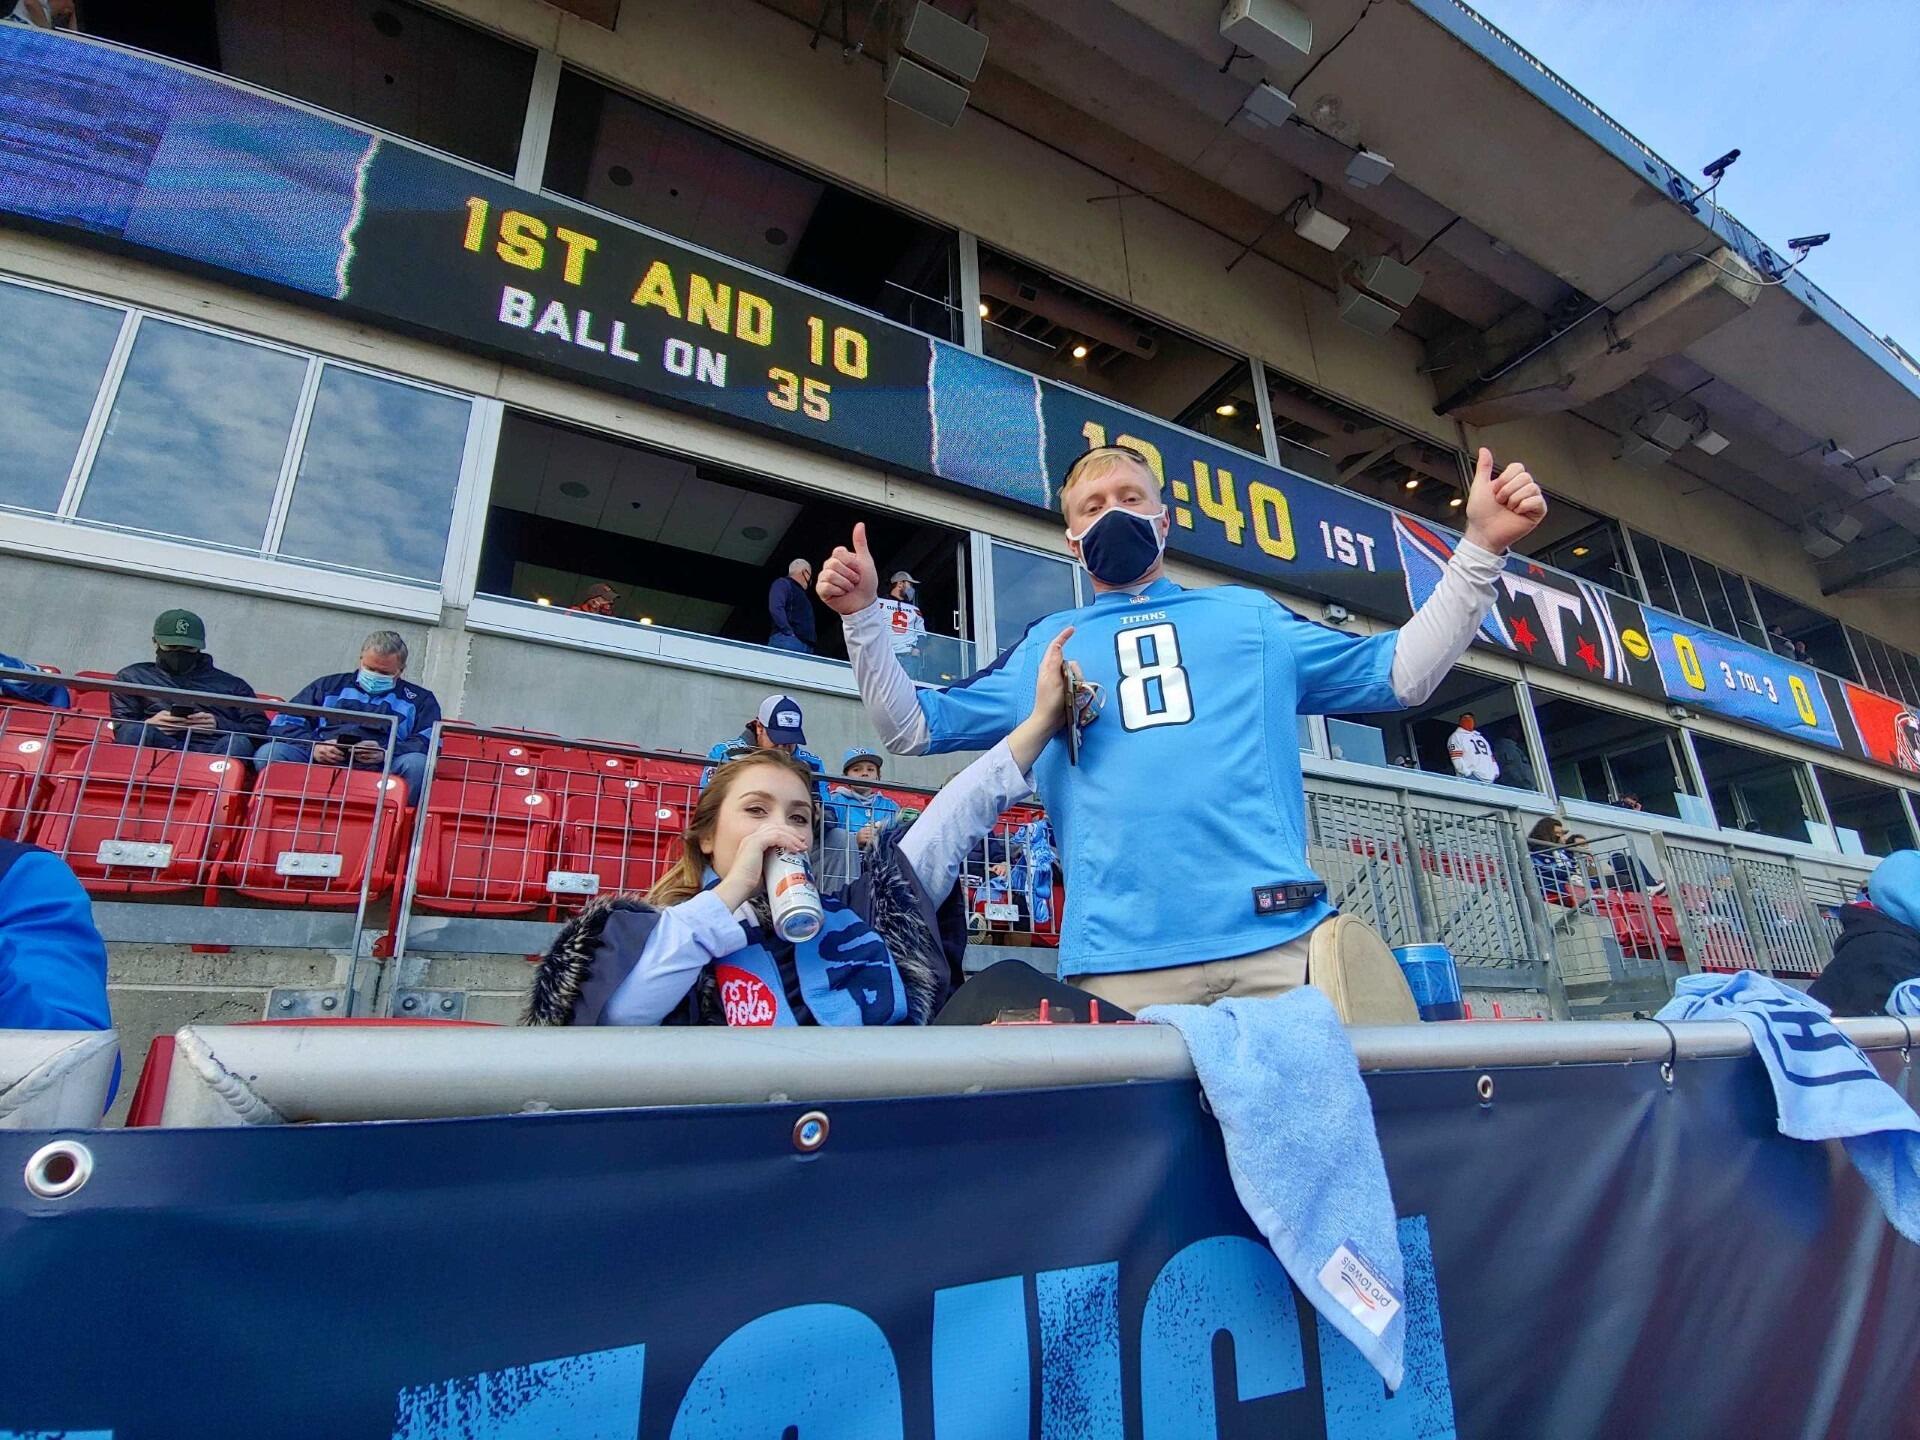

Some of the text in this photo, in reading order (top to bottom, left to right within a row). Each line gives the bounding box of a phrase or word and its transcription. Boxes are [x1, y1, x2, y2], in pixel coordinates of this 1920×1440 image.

[463, 196, 869, 380] 1ST AND 10
[498, 285, 831, 422] BALL ON 35
[1319, 520, 1375, 573] 1ST
[1120, 611, 1167, 625] TITANS
[1114, 622, 1195, 733] 8
[1672, 633, 1817, 727] 0 3 TOL 3 0
[1470, 739, 1488, 756] 19
[1341, 1257, 1372, 1291] towels
[1371, 1288, 1391, 1307] pro
